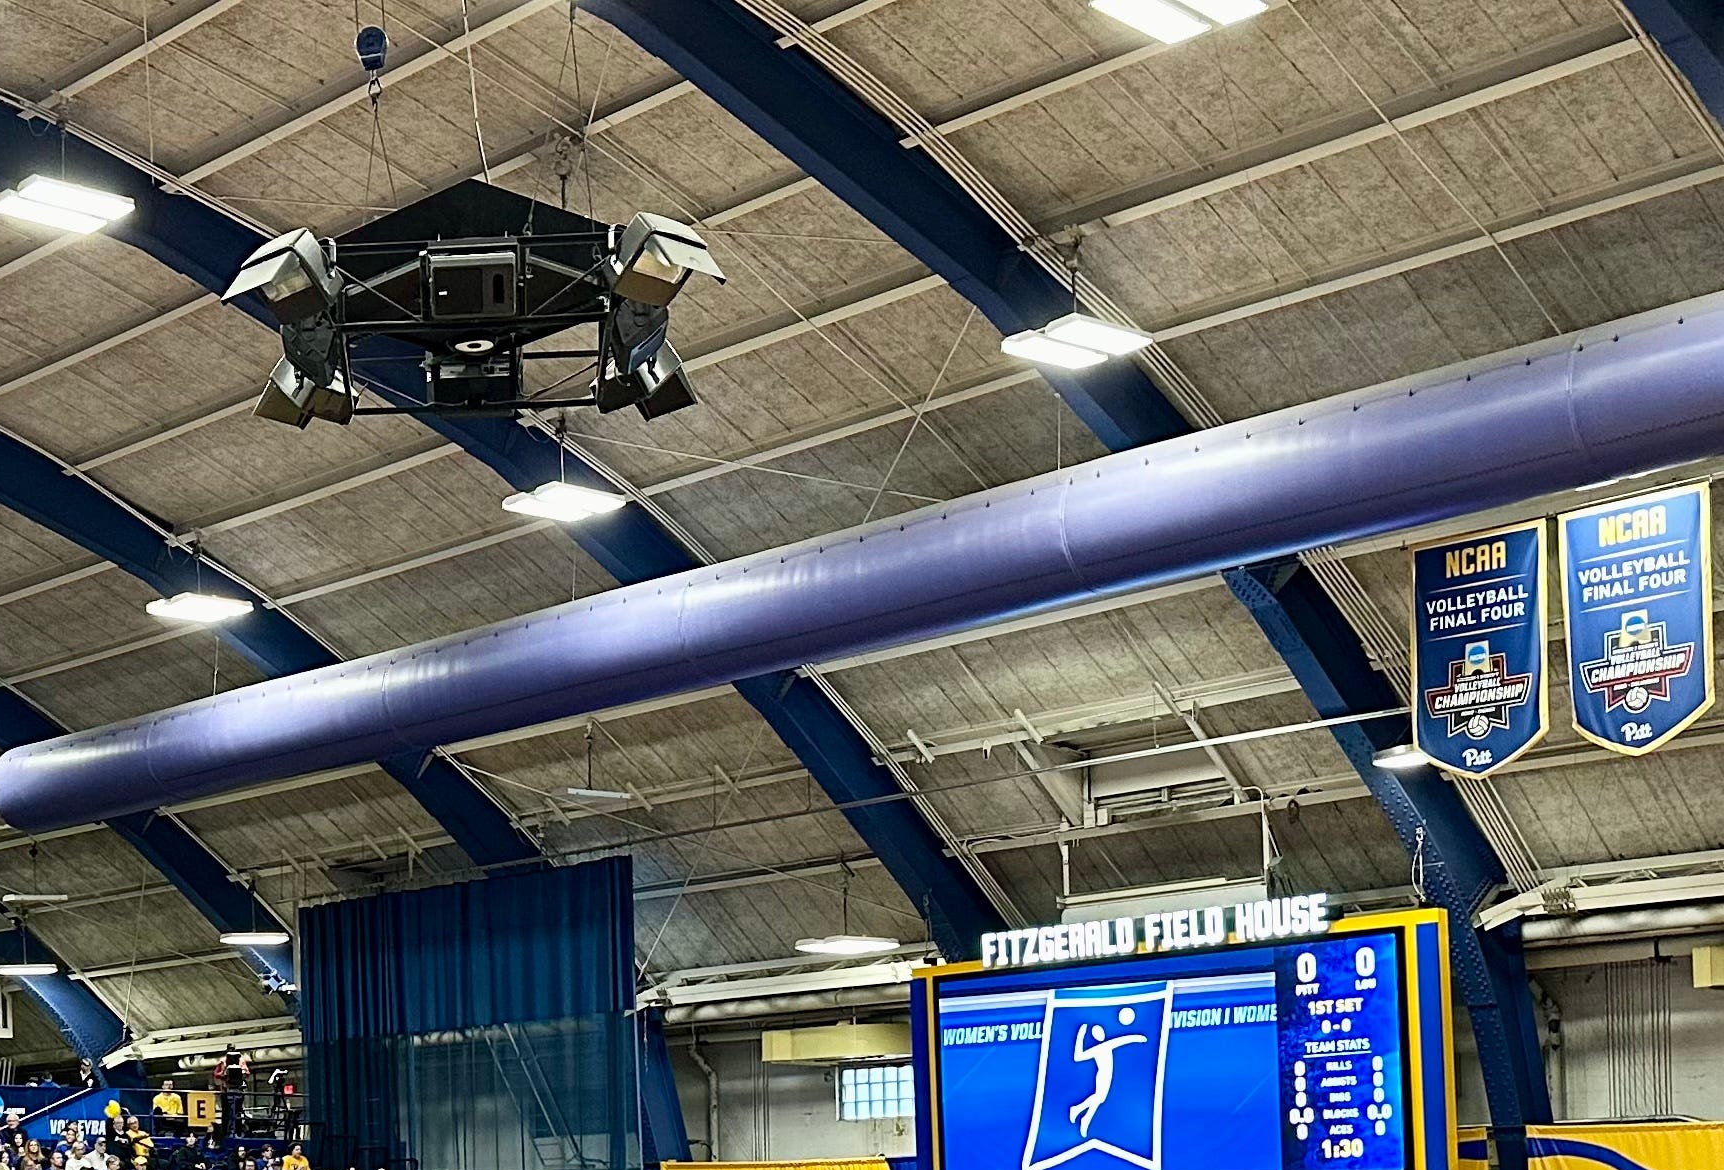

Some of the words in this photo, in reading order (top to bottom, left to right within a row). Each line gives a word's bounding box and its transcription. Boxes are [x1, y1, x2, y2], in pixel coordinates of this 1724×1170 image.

[1598, 505, 1667, 547] NCAA
[1445, 541, 1506, 578] NCAA
[1578, 550, 1691, 585] VOLLEYBALL
[1582, 581, 1635, 603] FINAL
[1638, 569, 1686, 591] FOUR
[1425, 584, 1529, 615] VOLLEYBALL
[1429, 613, 1477, 631] FINAL
[1481, 602, 1525, 623] FOUR
[1590, 652, 1687, 684] CHAMPIONSHIP
[1434, 683, 1524, 710] CHAMPIONSHIP
[1620, 721, 1653, 741] Pitt
[1462, 748, 1492, 767] Pitt
[980, 917, 1136, 968] FITZGERALD
[1144, 906, 1225, 951] FIELD
[1234, 892, 1329, 942] HOUSE
[1297, 952, 1317, 983] 0
[1355, 946, 1375, 977] 0
[1295, 982, 1320, 997] PITT
[1355, 978, 1377, 991] LOU
[1233, 1003, 1277, 1024] WOME
[1308, 999, 1334, 1016] 1ST
[1335, 997, 1364, 1013] SET
[943, 1024, 1008, 1046] WOMEN'S
[1010, 1021, 1042, 1041] VOLL
[1305, 1040, 1336, 1053] TEAM
[1336, 1037, 1370, 1051] STATS
[1294, 1060, 1306, 1077] 0
[1372, 1055, 1383, 1071] 0
[1294, 1076, 1306, 1092] 0
[1372, 1071, 1384, 1087] 0
[1295, 1091, 1307, 1107] 0
[1373, 1087, 1385, 1103] 0
[197, 1100, 206, 1119] E
[1289, 1107, 1314, 1125] 0.0
[1366, 1103, 1393, 1120] 0.0
[1296, 1123, 1308, 1140] 0
[1374, 1120, 1386, 1136] 0
[1321, 1138, 1364, 1159] 1:30
